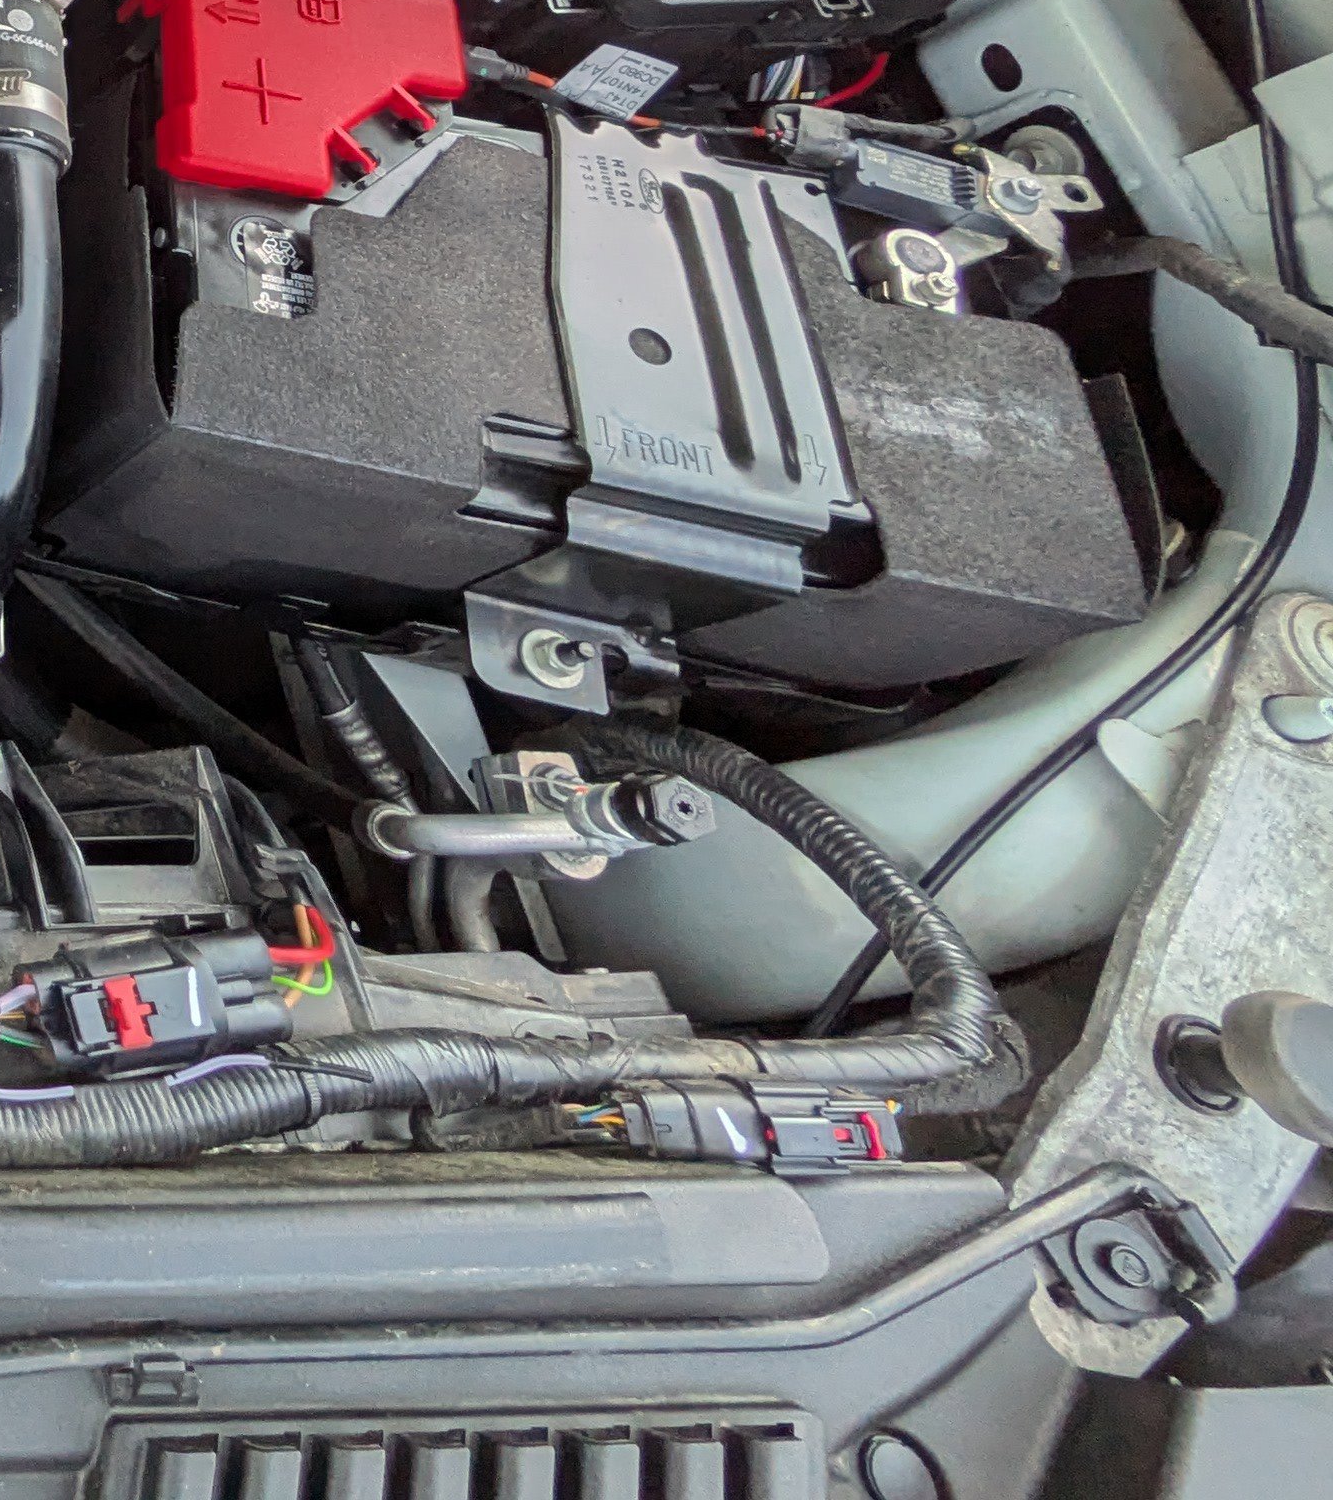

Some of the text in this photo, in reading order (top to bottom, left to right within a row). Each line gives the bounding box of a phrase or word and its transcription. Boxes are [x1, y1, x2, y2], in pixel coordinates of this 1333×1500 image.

[577, 155, 598, 202] 17321
[610, 159, 635, 209] H210A
[621, 427, 714, 476] FRONT
